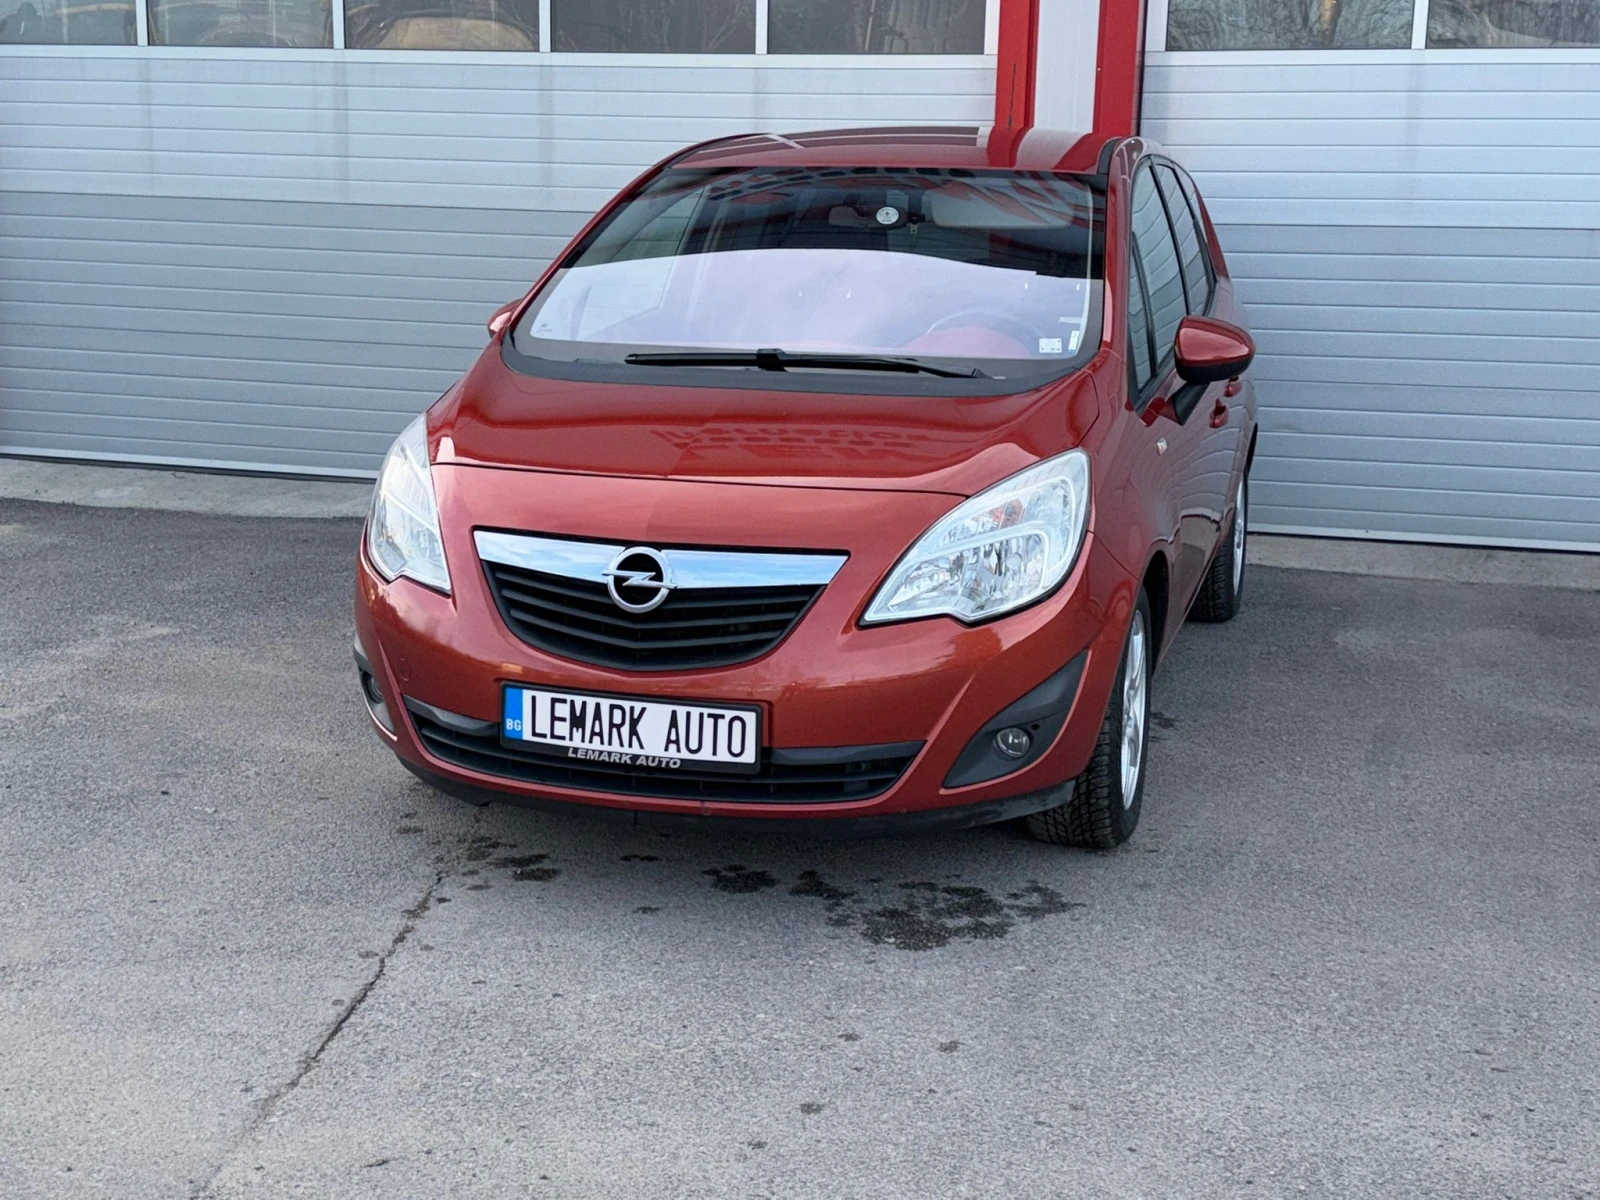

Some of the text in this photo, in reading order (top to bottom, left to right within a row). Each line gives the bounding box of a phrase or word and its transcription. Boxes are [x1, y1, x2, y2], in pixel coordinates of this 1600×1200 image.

[506, 717, 522, 732] BG
[530, 695, 747, 758] LEMARK AUTO
[568, 747, 682, 770] LEMARK AUTO
